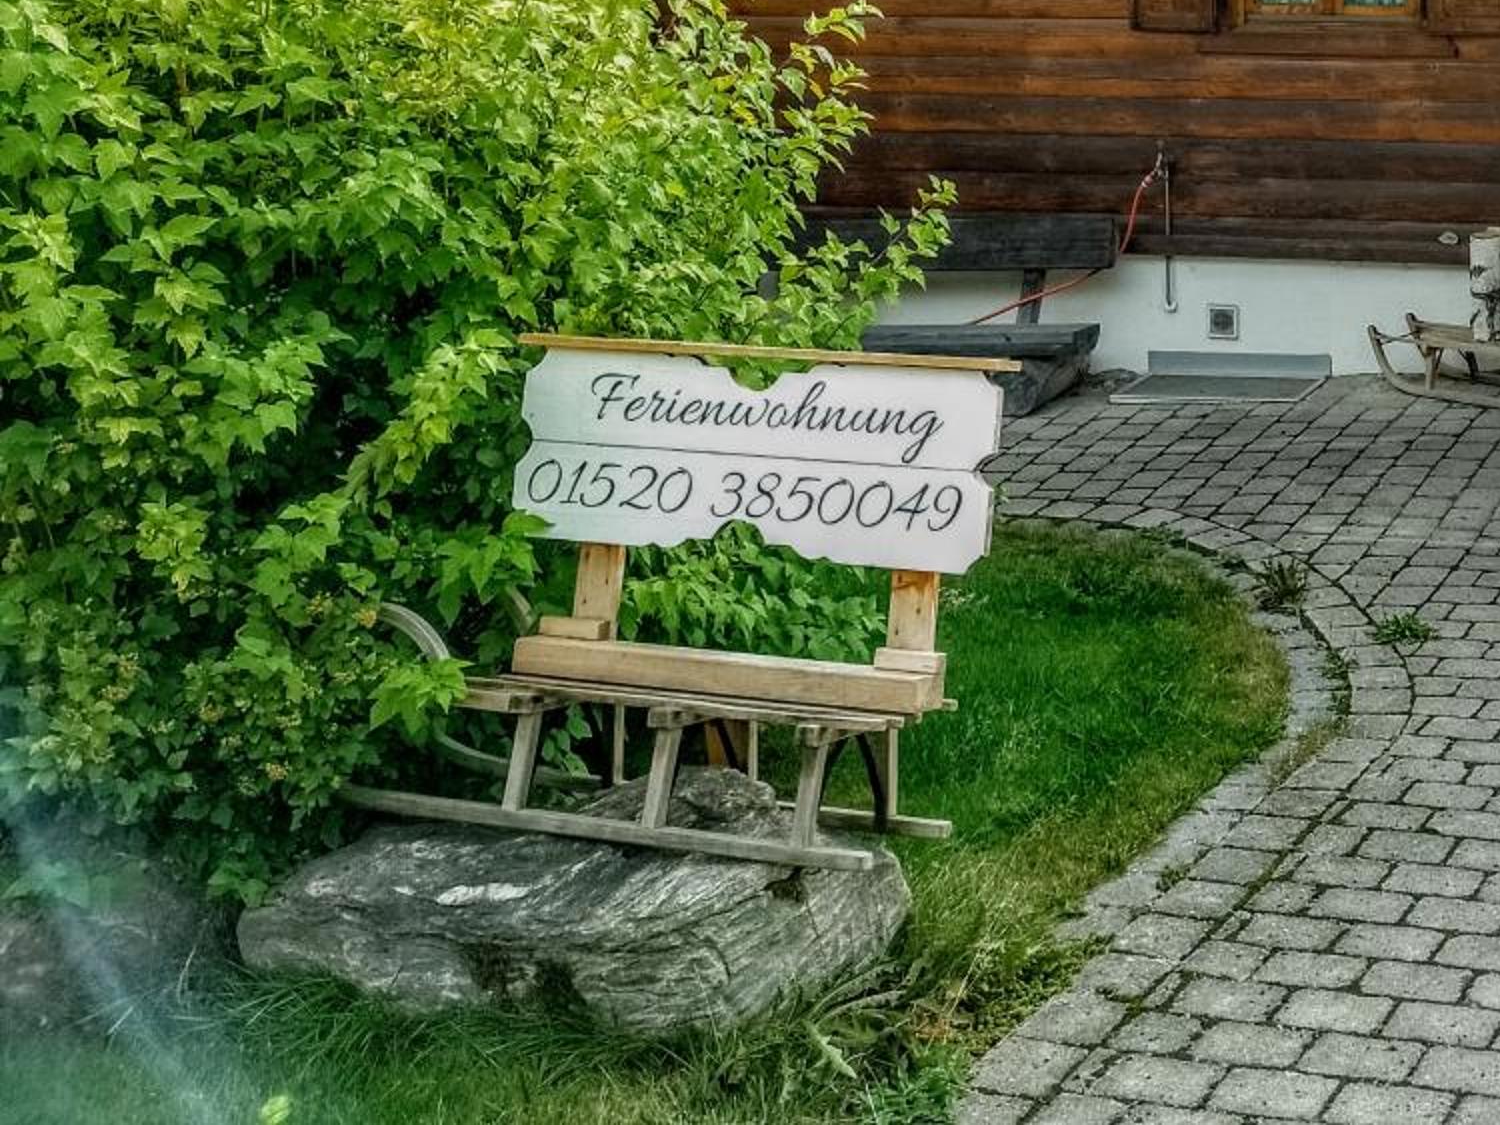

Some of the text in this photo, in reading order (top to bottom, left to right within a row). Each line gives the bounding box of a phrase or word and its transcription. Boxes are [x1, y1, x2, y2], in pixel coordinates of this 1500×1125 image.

[591, 372, 943, 464] Ferienwohnung
[527, 459, 963, 532] 01520 3850049
